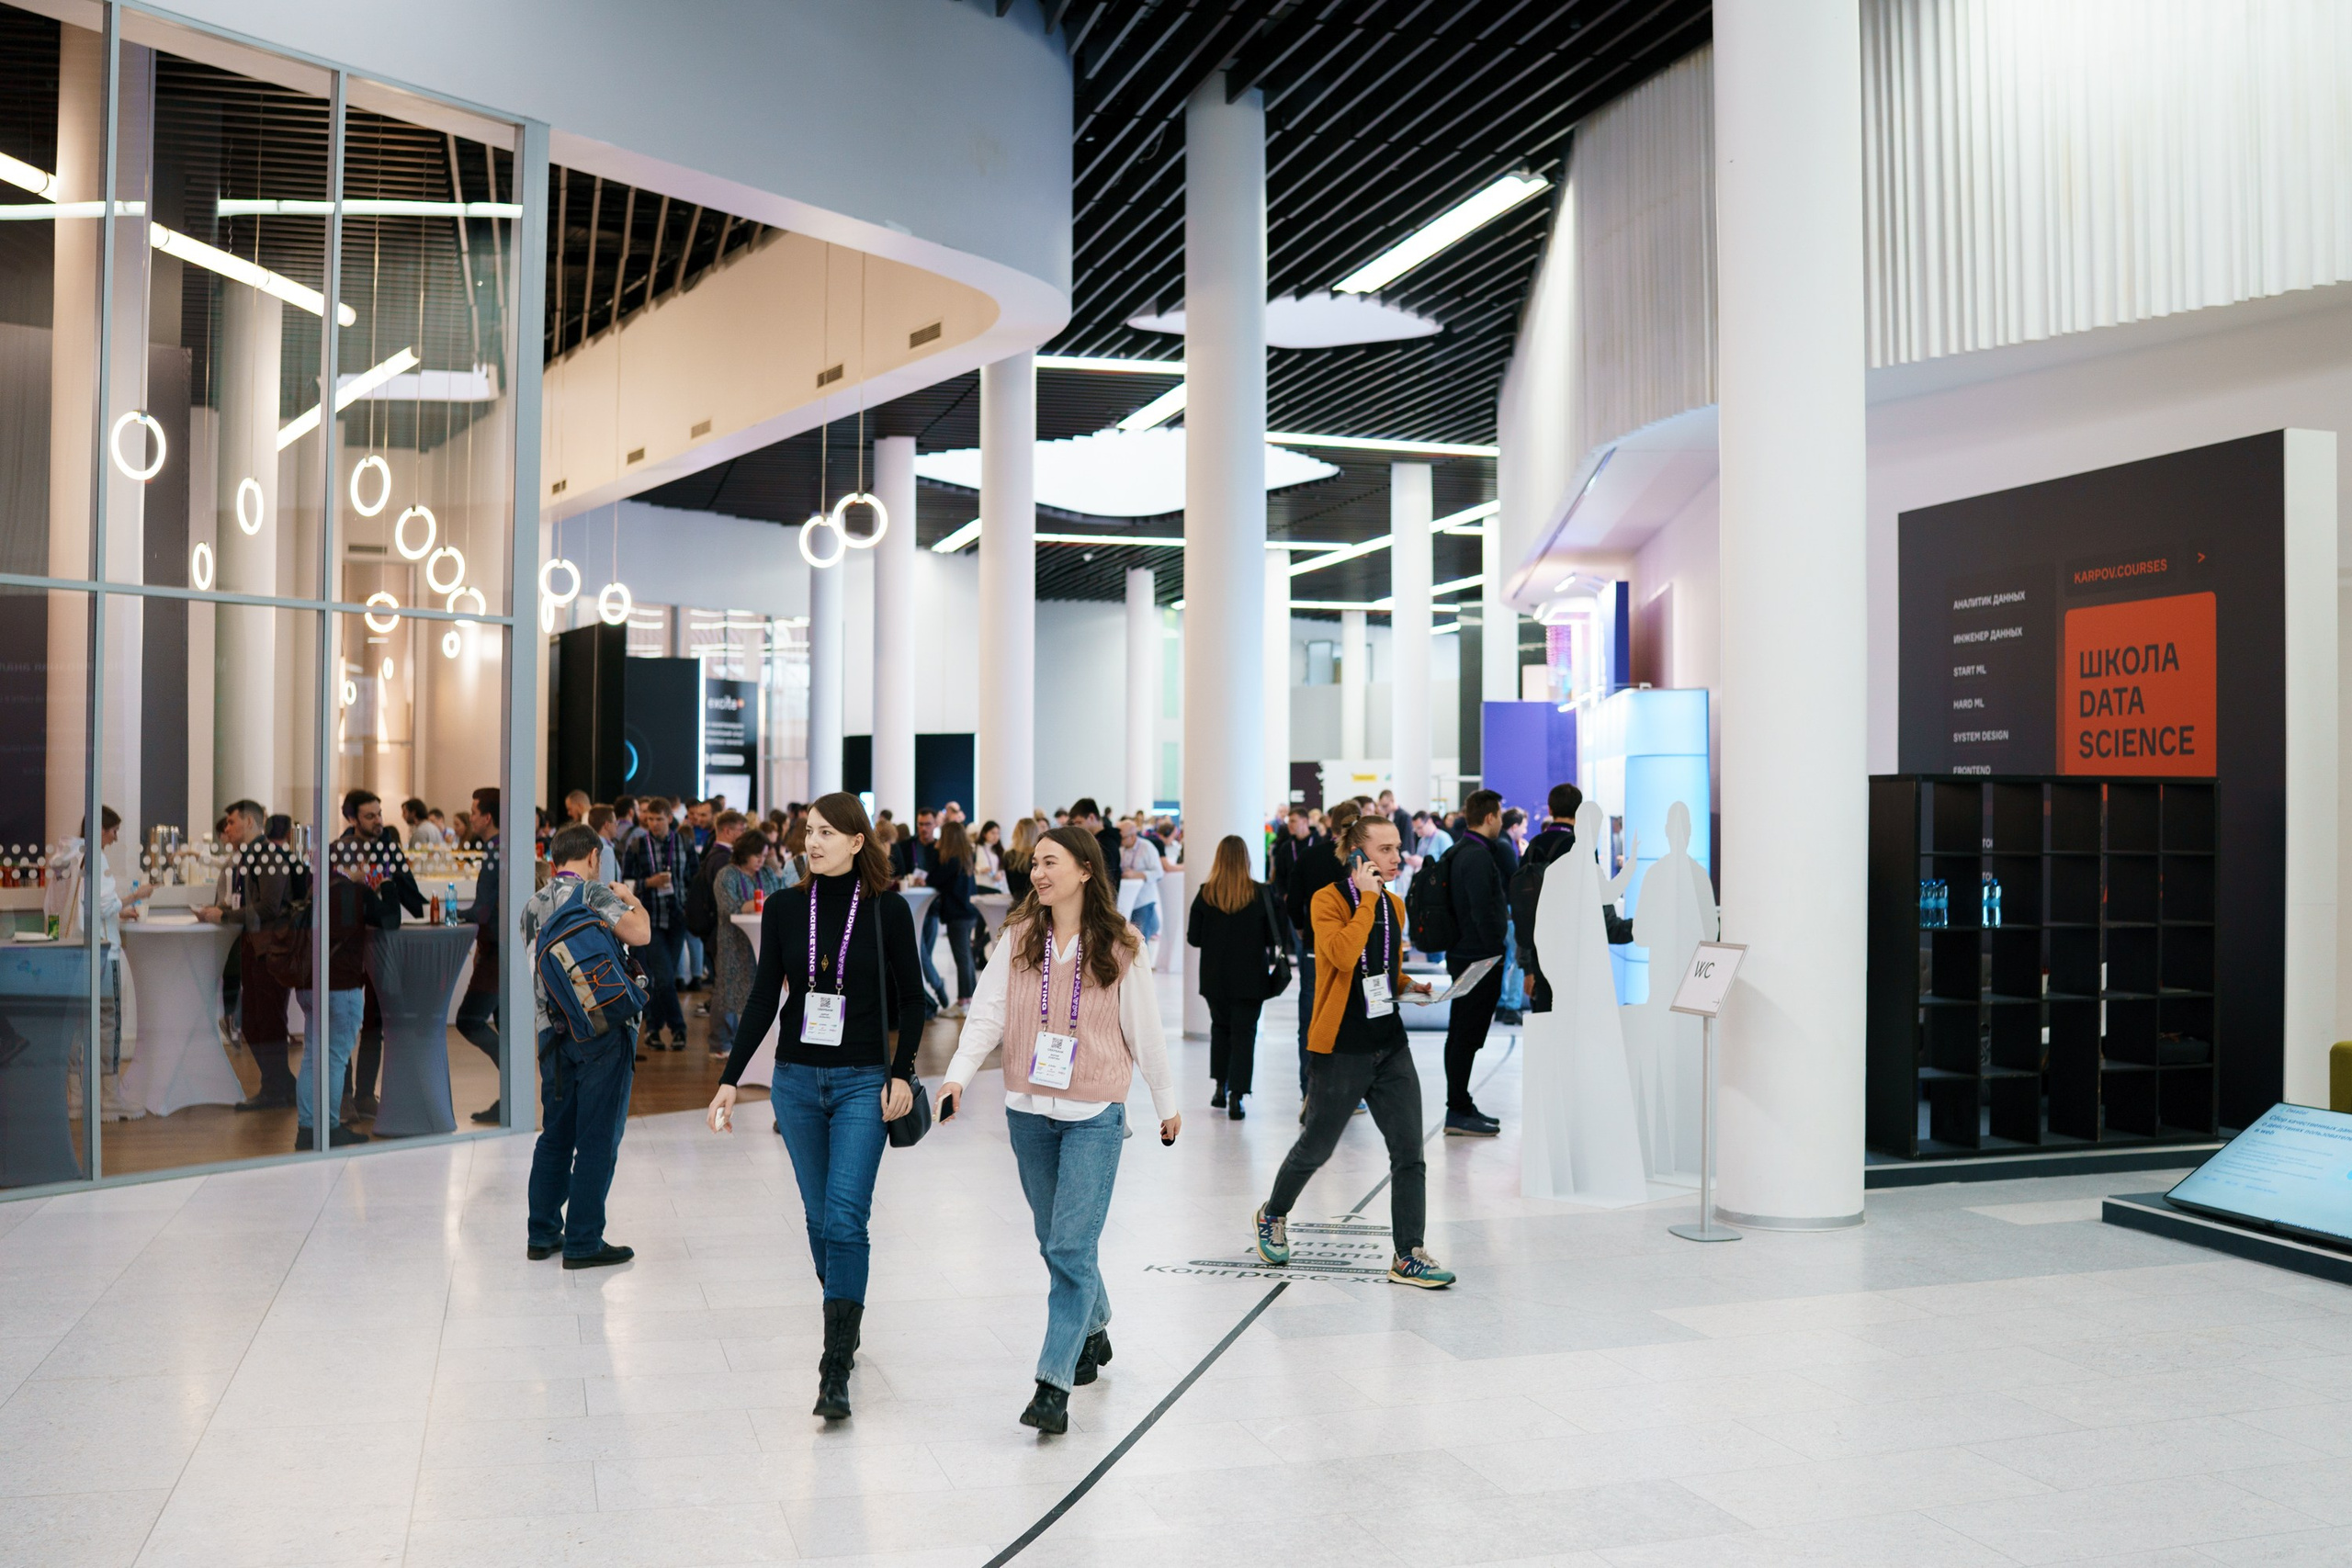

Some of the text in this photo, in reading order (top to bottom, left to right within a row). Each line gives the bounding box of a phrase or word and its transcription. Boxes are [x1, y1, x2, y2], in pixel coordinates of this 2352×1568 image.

[2074, 558, 2167, 584] KARPOV.COURSES
[1953, 590, 2026, 611] АНАЛИТИК ДАННЫХ
[1953, 626, 2023, 644] ИНЖЕНЕР ДАННЫХ
[2080, 642, 2179, 679] ШКОЛА
[1953, 664, 1987, 677] START ML
[1953, 698, 1984, 710] HARD ML
[2080, 686, 2145, 717] DATA
[1953, 729, 2009, 743] SYSTEM DESIGN
[2079, 725, 2195, 760] SCIENCE
[1953, 764, 1991, 775] FRONTEND
[1693, 960, 1715, 978] WC
[1289, 1240, 1380, 1249] итай
[1143, 1265, 1391, 1284] Конгресс-хо
